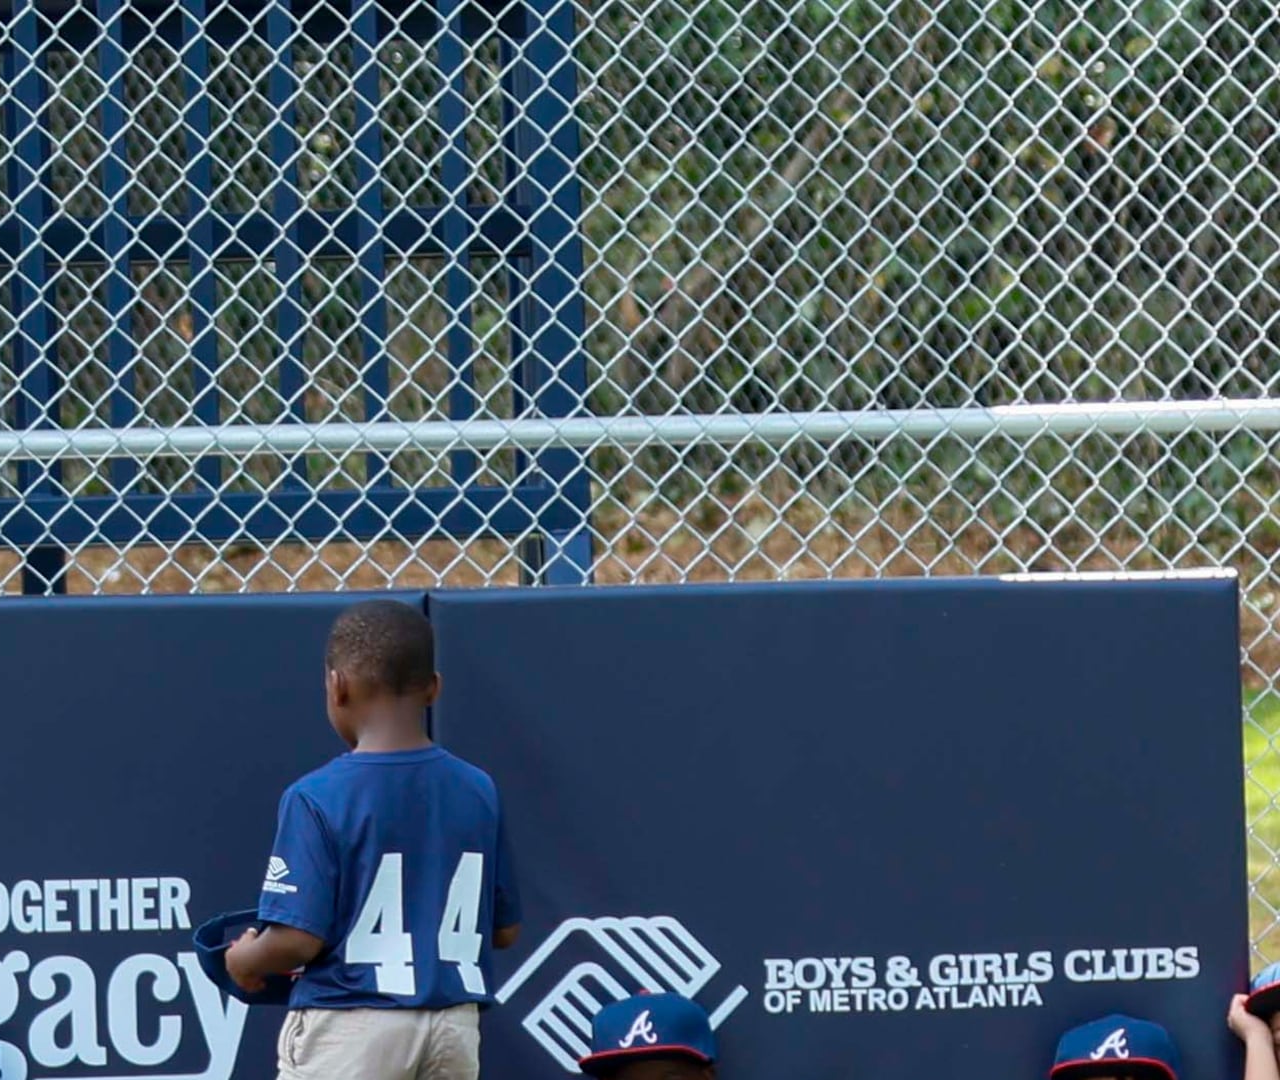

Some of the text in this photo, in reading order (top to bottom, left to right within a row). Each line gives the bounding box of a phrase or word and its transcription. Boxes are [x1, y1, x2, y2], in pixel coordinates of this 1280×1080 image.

[345, 852, 486, 996] 44
[763, 946, 1200, 990] BOYS & GIRLS CLUBS
[763, 983, 1043, 1013] OF METRO ATLANTA
[618, 1009, 658, 1048] A
[1090, 1028, 1129, 1060] A
